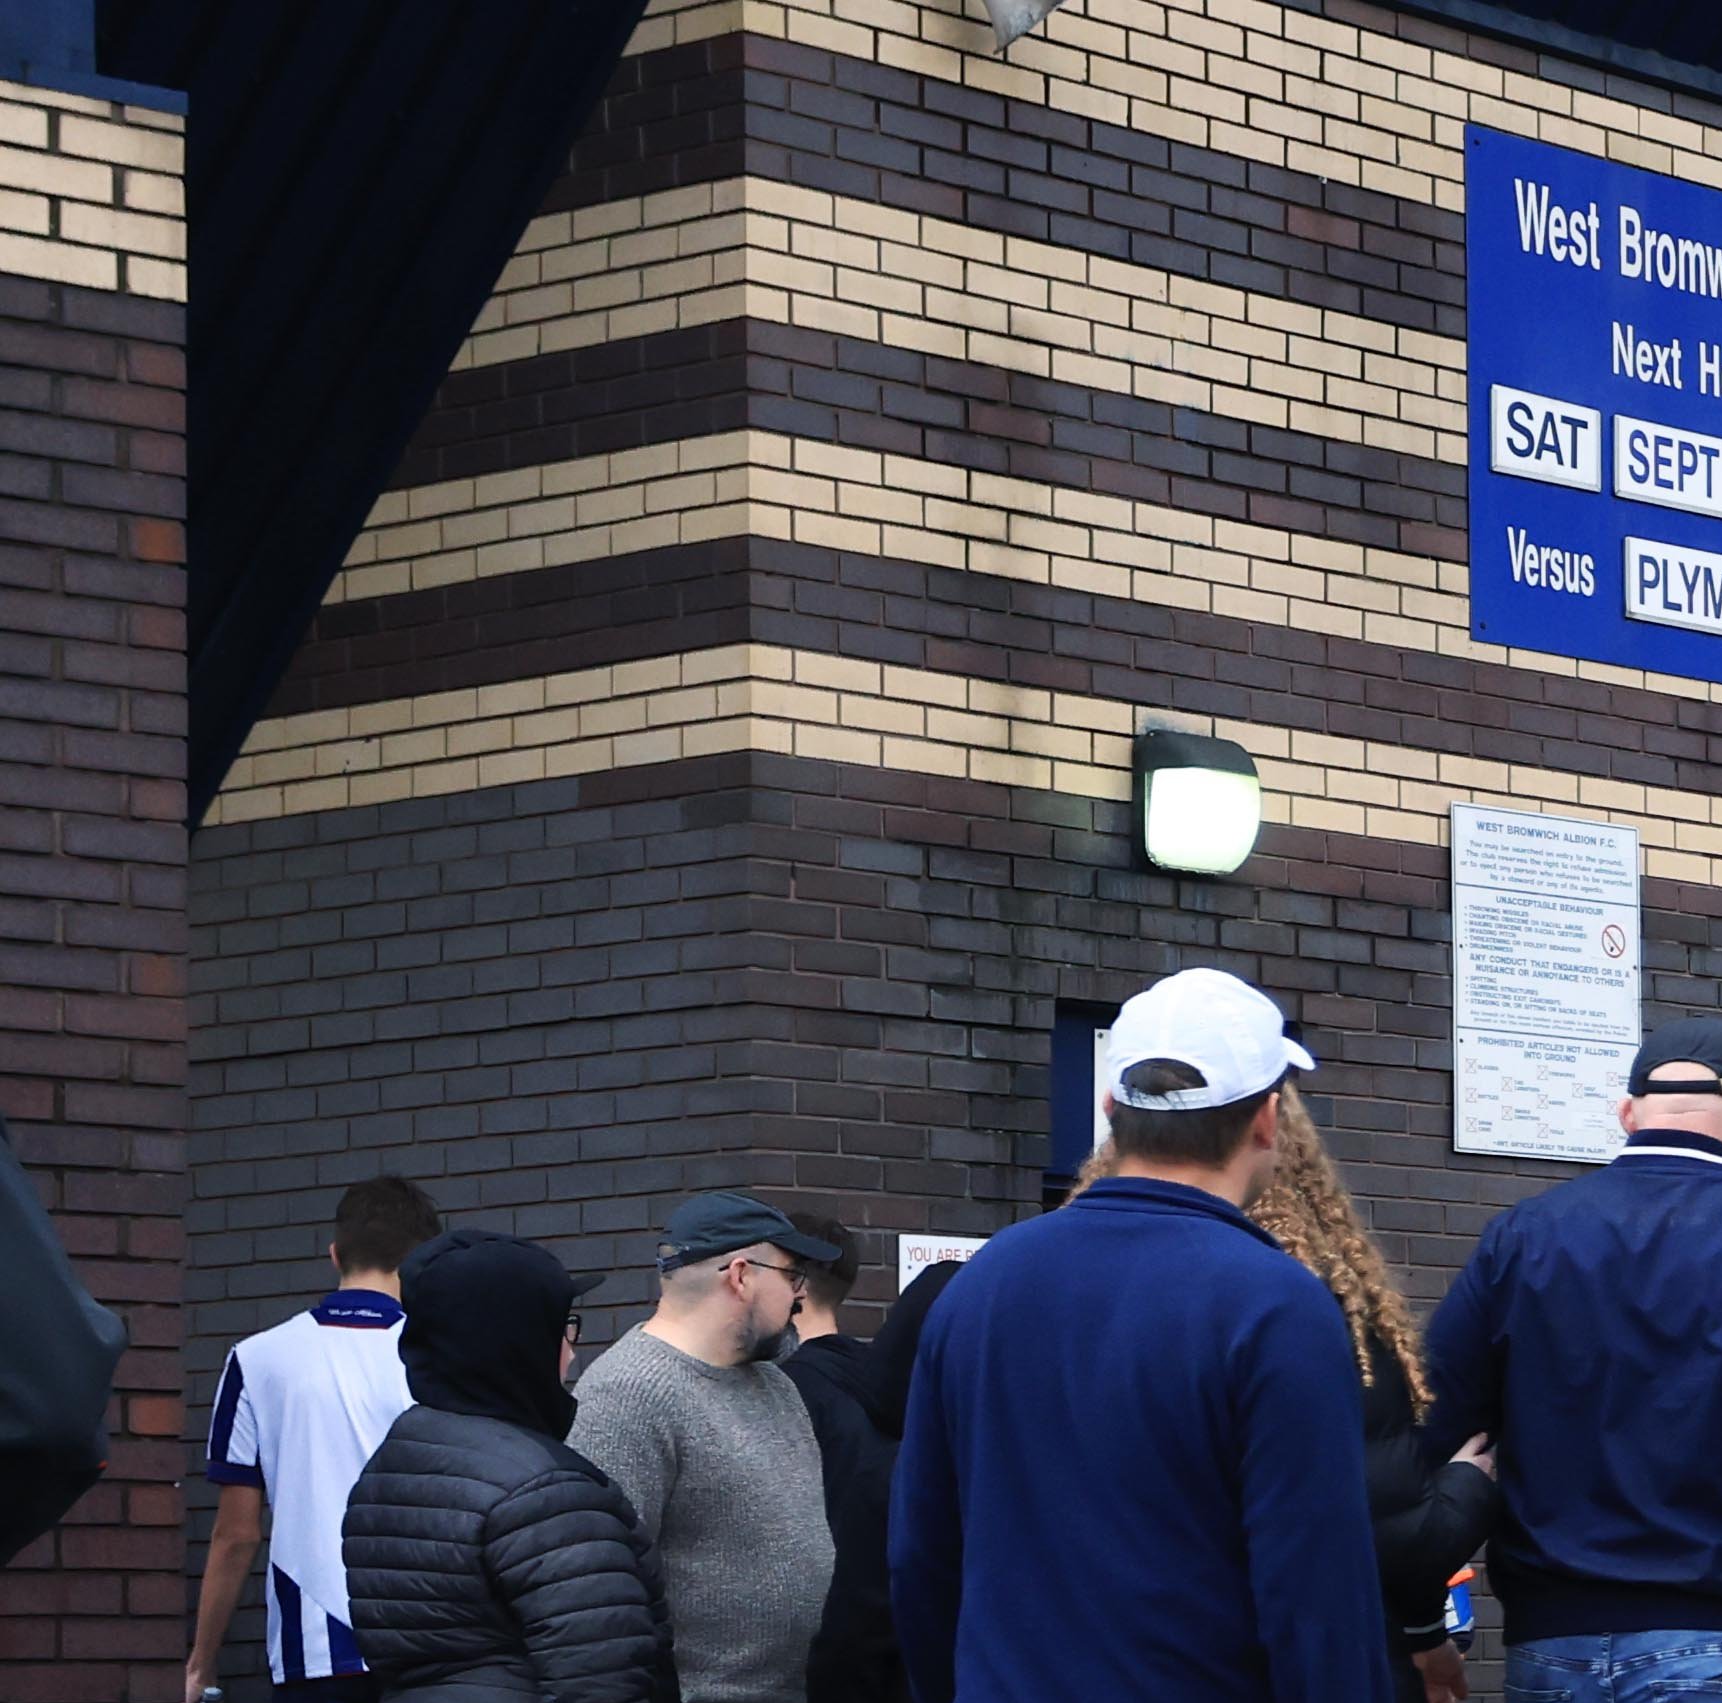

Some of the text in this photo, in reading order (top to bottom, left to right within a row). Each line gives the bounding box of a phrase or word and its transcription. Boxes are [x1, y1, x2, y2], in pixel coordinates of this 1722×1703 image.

[1513, 178, 1601, 271] West
[1611, 321, 1682, 391] Next
[1505, 401, 1589, 471] SAT
[1627, 429, 1720, 499] SEPT
[1506, 525, 1595, 597] Versus
[1476, 821, 1504, 832] WEST
[1507, 825, 1559, 841] BROMWICH
[1563, 832, 1597, 846] ALBION
[1469, 905, 1500, 914] THROWING
[1496, 896, 1604, 916] UNACCEPTABLE BEHAVIOUR
[1469, 912, 1499, 921] CHANTING
[1502, 916, 1528, 925] OBSCENE
[1469, 920, 1493, 928] MAKING
[1469, 935, 1511, 945] THREATENING
[1470, 953, 1486, 961] ANY
[1489, 955, 1526, 967] CONDUCT
[1530, 960, 1549, 968] THAT
[1552, 962, 1599, 974] ENDANGERS
[1602, 968, 1612, 976] OR
[1615, 969, 1621, 977] IS
[1475, 964, 1625, 987] NUISANCE OR ANNOYANCE TO OTHERS
[1477, 1036, 1620, 1058] PROHIBITED ARTICLES NOT ALLOWED
[1523, 1051, 1577, 1063] INTO GROUND
[907, 1246, 932, 1262] YOU
[937, 1247, 961, 1262] ARE
